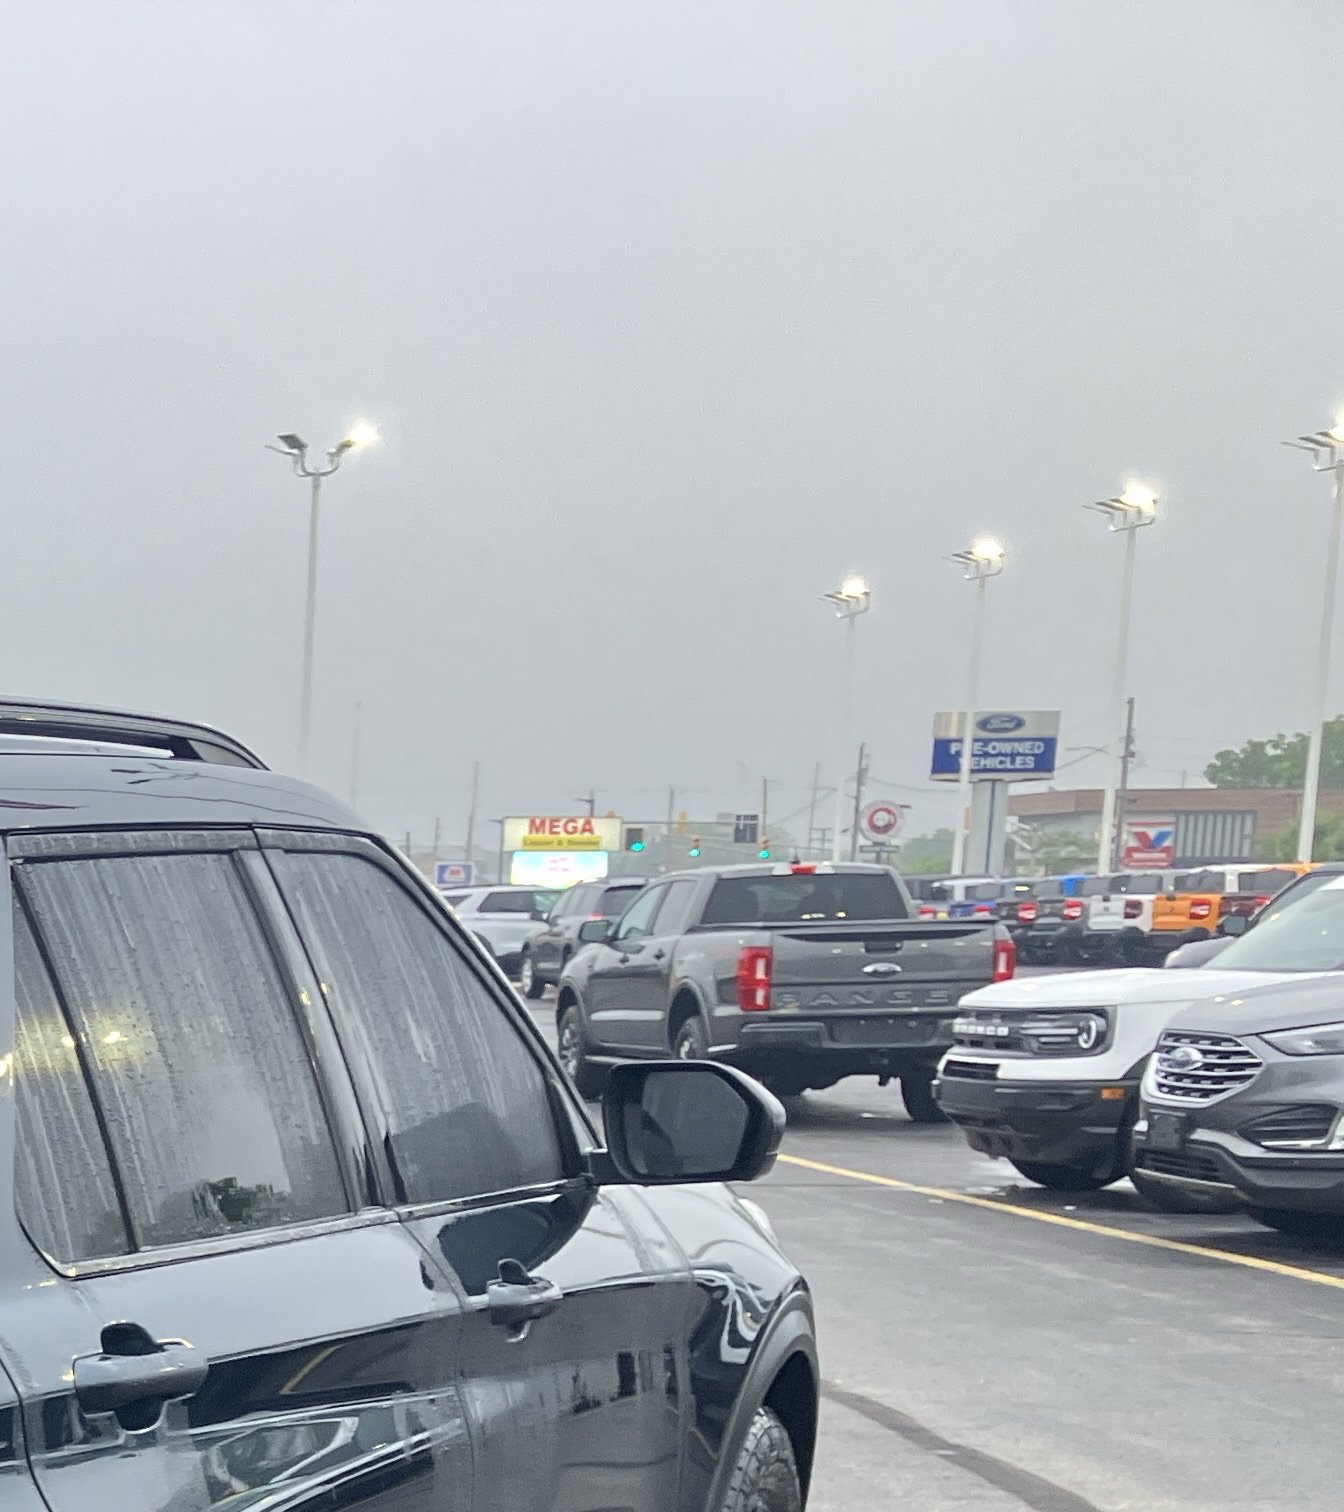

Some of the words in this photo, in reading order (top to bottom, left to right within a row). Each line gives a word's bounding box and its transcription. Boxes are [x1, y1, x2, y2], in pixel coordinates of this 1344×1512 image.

[950, 740, 1045, 755] PE-OWNED
[527, 816, 596, 836] MEGA
[775, 990, 950, 1010] RANGE
